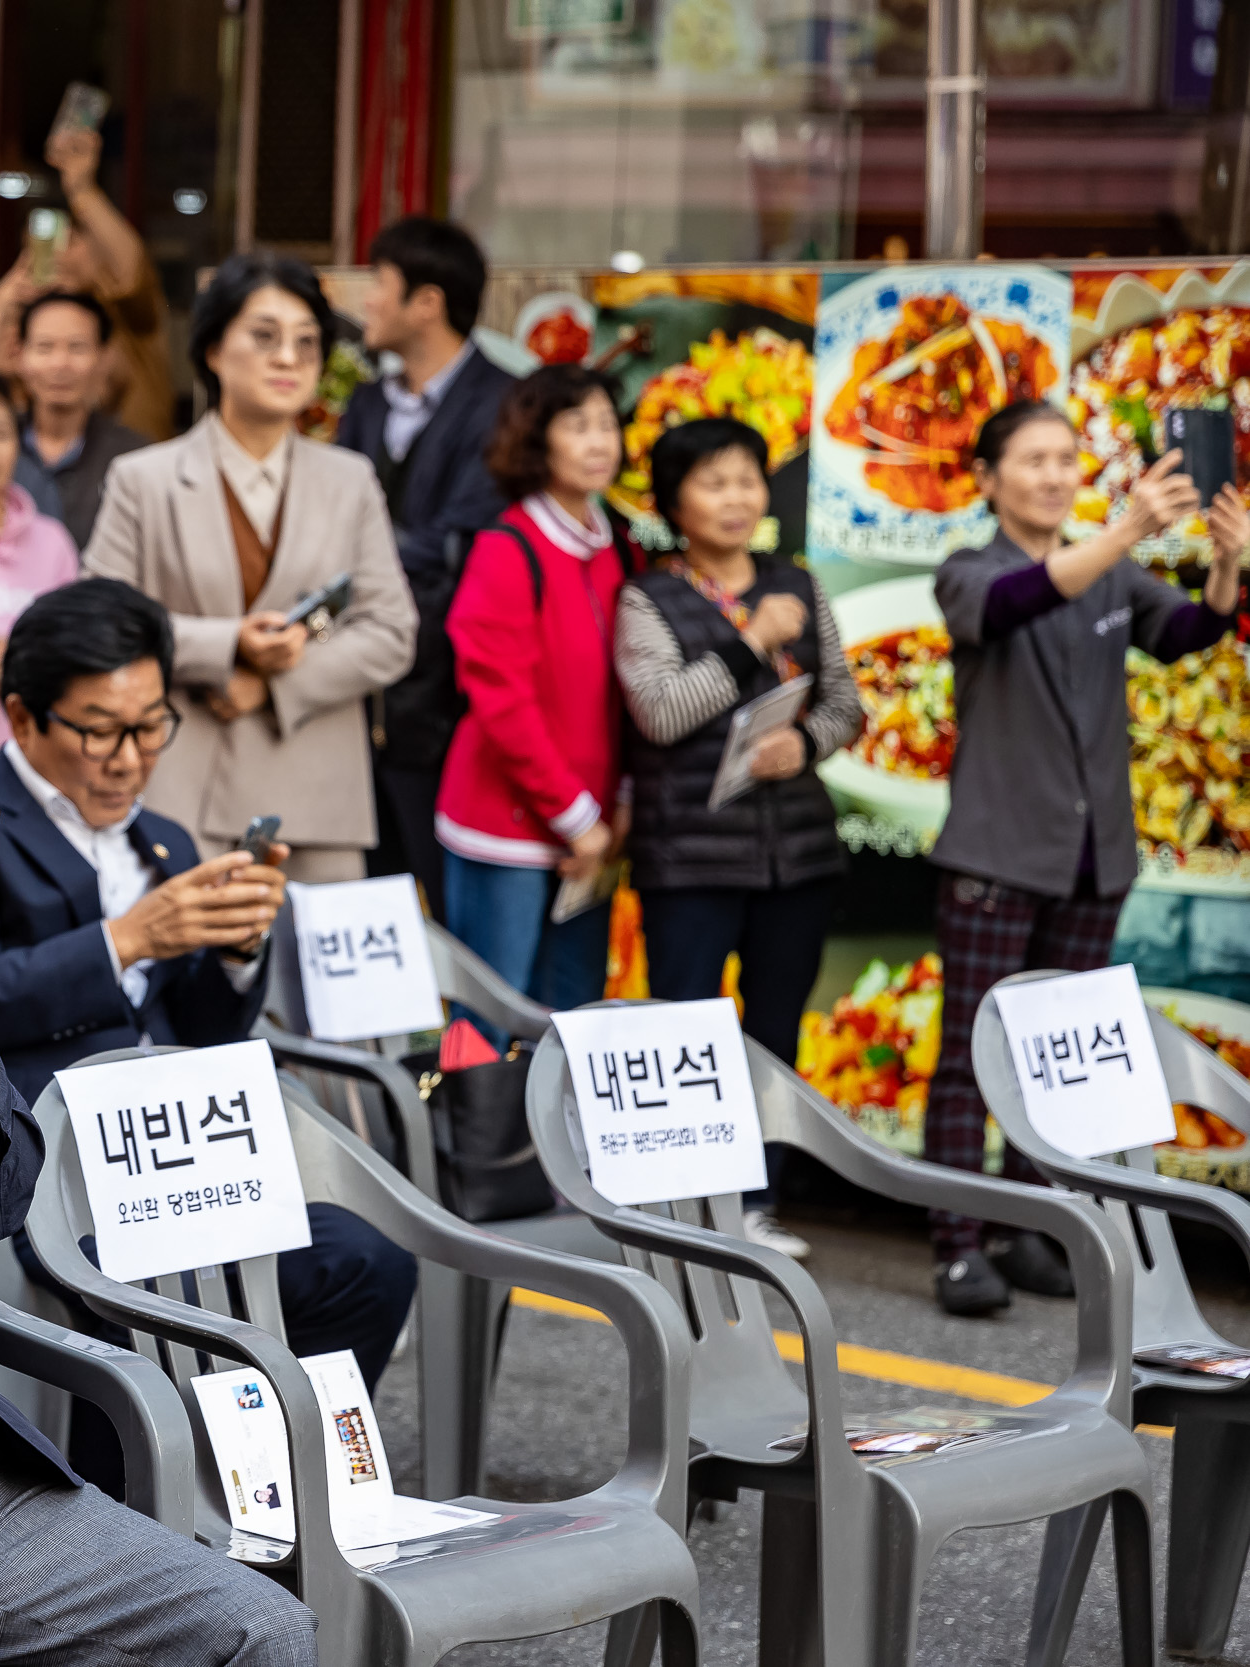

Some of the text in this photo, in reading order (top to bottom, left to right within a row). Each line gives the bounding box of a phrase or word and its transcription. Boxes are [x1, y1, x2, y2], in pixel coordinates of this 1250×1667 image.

[588, 1043, 722, 1111] 내빈석
[1022, 1021, 1132, 1091] 내빈석
[97, 1090, 257, 1175] 내빈석
[702, 1123, 735, 1145] 의장
[118, 1179, 262, 1224] 오신환 당협위원장
